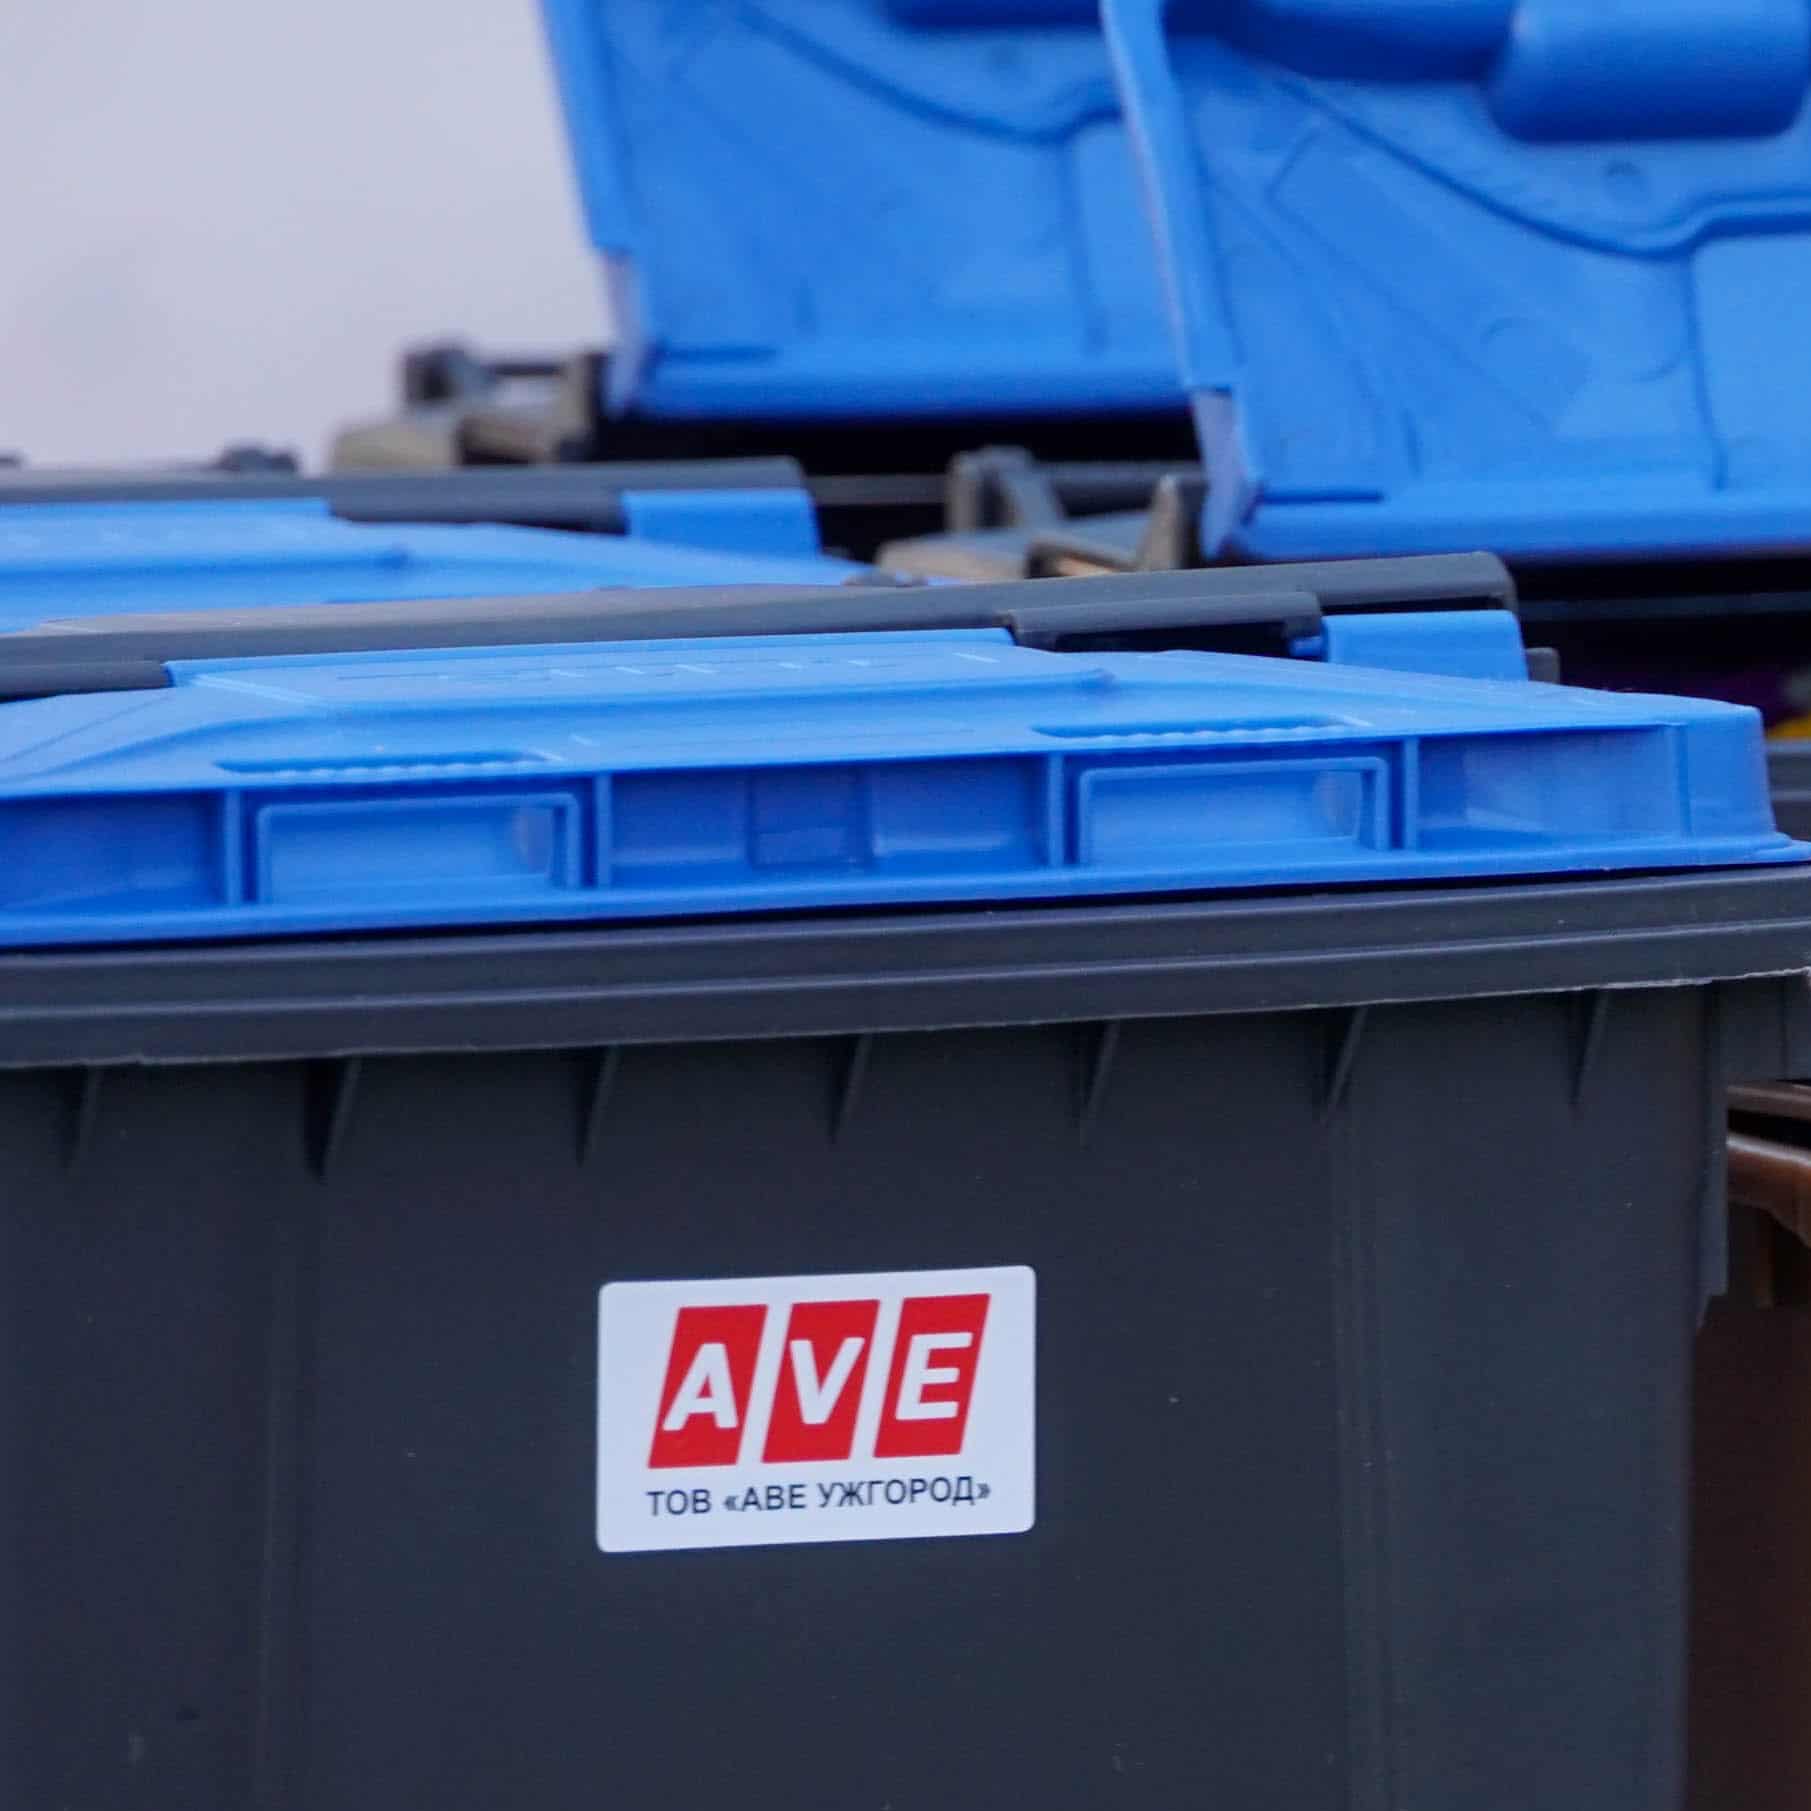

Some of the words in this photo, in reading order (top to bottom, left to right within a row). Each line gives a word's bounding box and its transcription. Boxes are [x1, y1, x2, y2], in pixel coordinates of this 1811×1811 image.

[659, 1328, 976, 1434] AVE
[646, 1488, 712, 1518] ТОВ
[723, 1483, 808, 1514] «АВЕ
[817, 1475, 992, 1510] УЖГОРОД»
